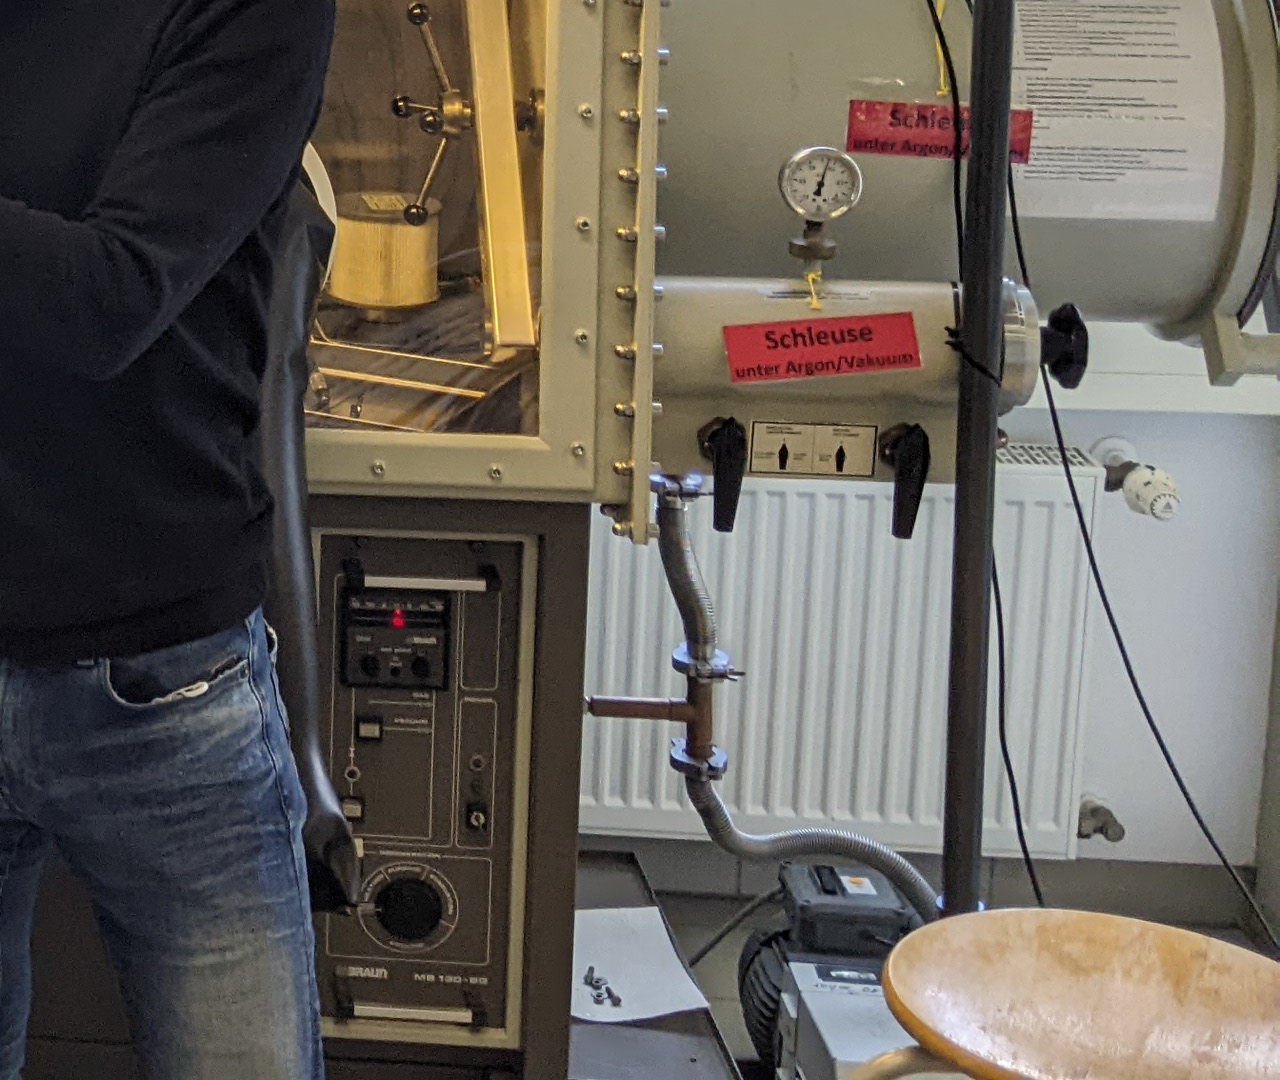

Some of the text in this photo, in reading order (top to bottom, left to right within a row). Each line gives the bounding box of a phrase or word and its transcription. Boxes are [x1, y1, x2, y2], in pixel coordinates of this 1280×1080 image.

[765, 326, 873, 349] Schleuse
[735, 352, 913, 378] unter Argon/Vakuum
